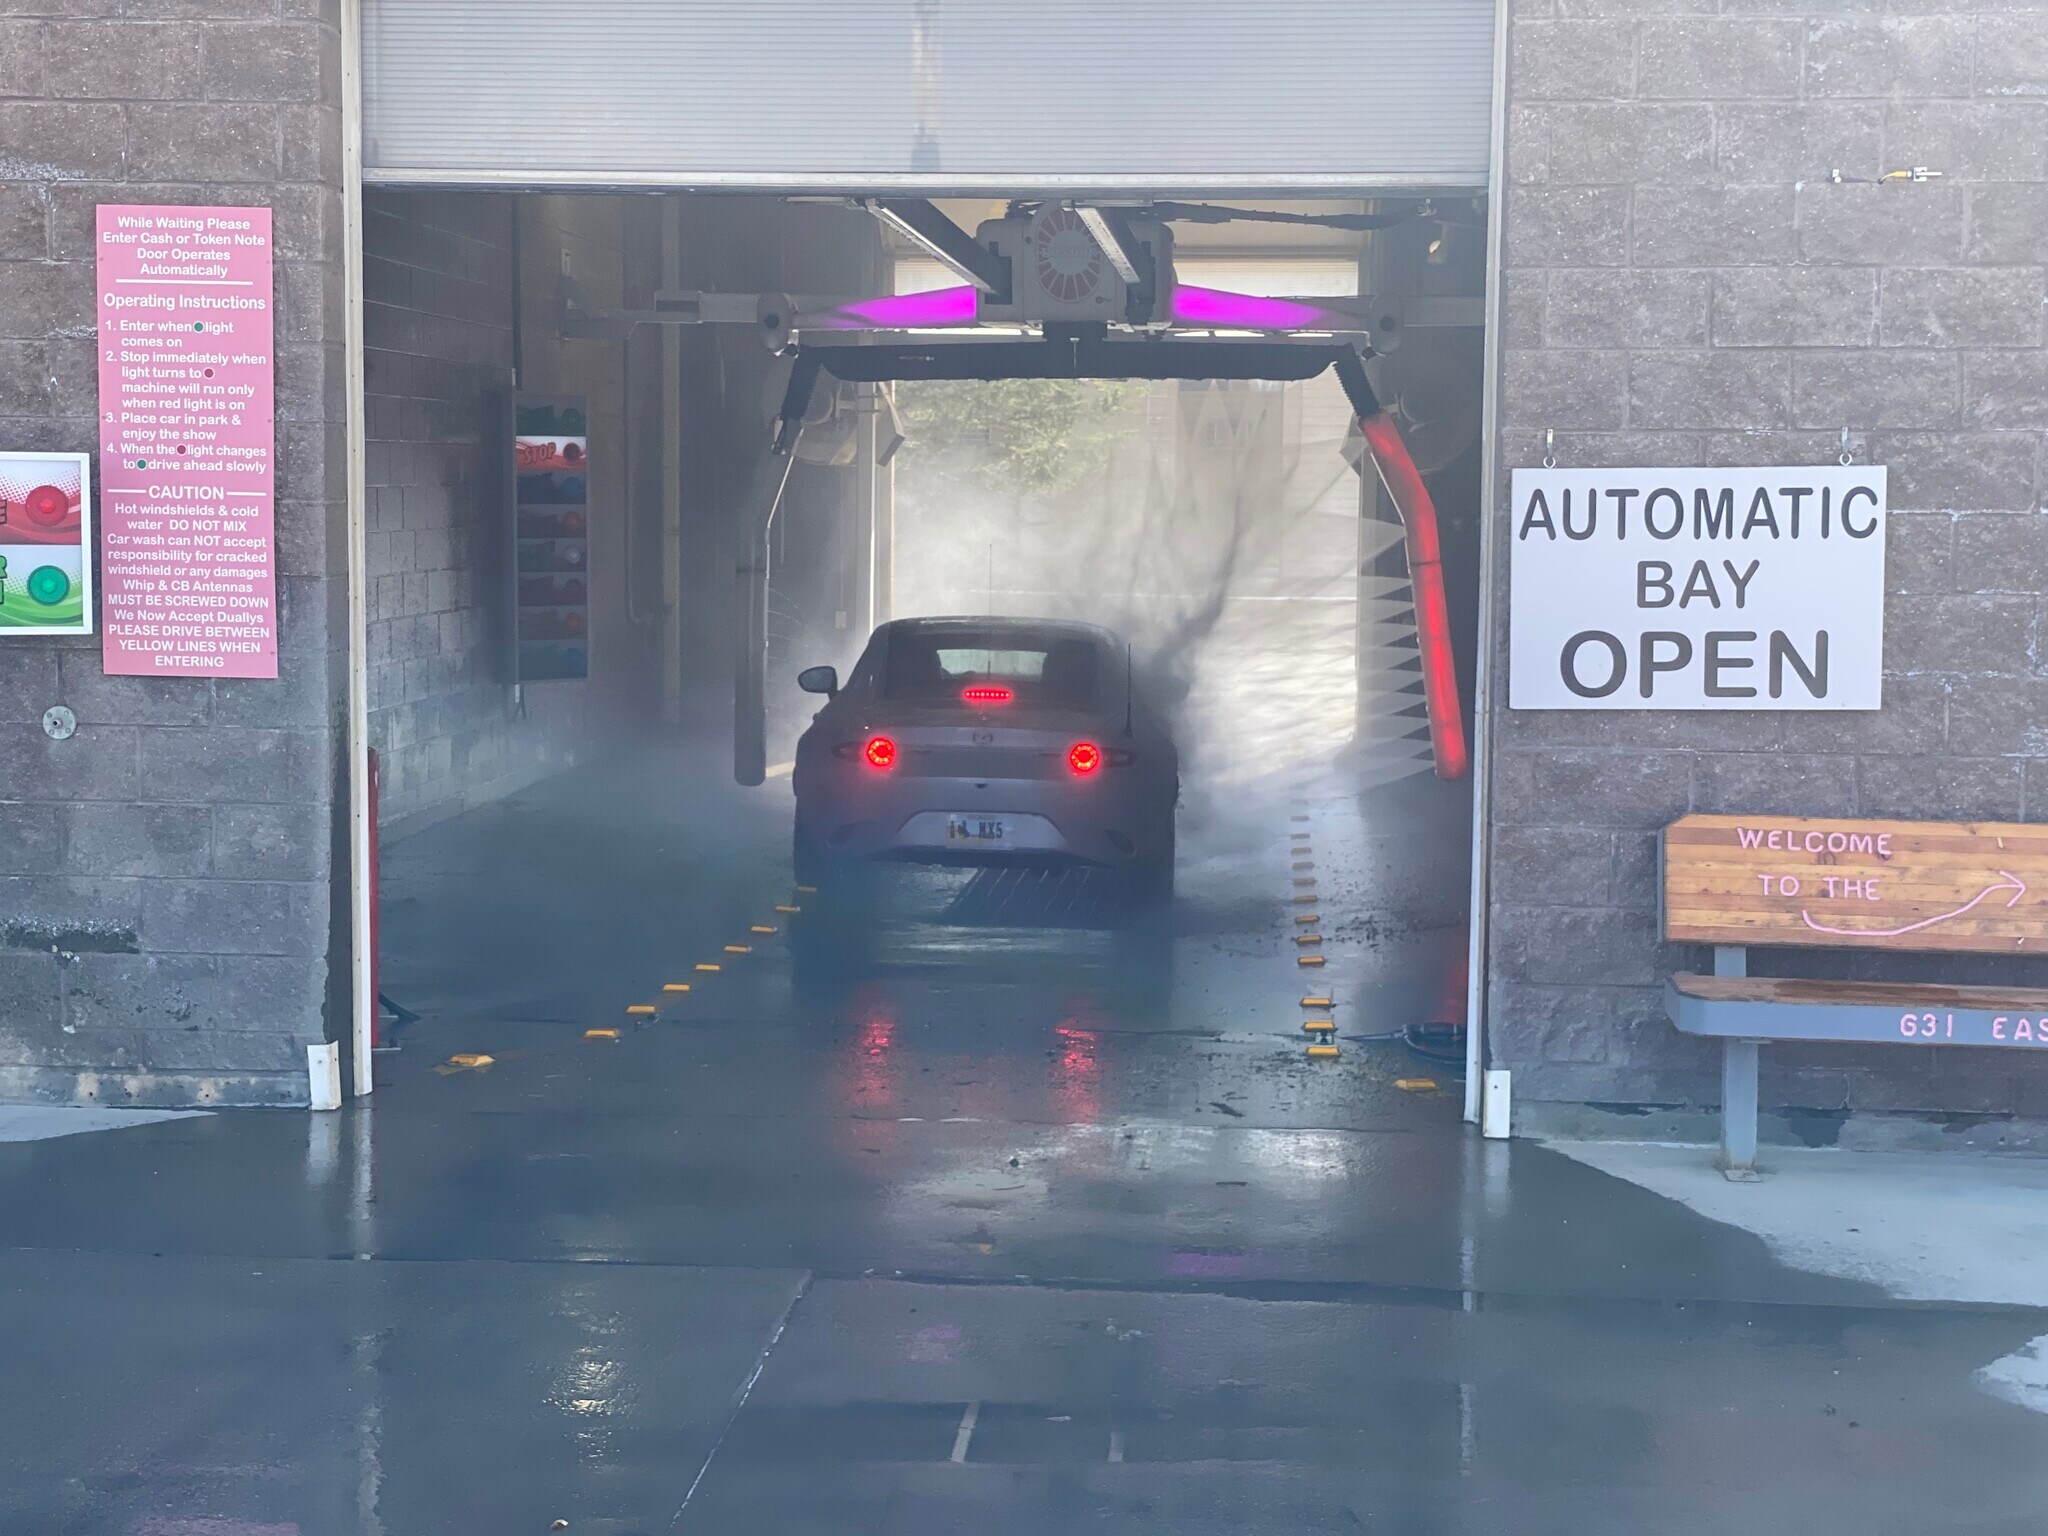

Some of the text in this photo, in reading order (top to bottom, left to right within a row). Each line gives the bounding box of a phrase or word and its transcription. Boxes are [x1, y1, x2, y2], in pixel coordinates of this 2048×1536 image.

[118, 216, 250, 232] While Waiting Please
[103, 232, 265, 246] Enter Cash or Token Note
[137, 248, 231, 262] Door Operates
[140, 263, 228, 278] Automatically
[104, 293, 266, 311] Operating Instructions
[105, 320, 234, 335] 1. Enter when light
[121, 338, 182, 347] comes on
[106, 350, 266, 366] 2. Stop immediately when
[122, 366, 202, 380] light turns to
[122, 382, 255, 398] machine will run only
[122, 397, 245, 412] when red light is on
[106, 412, 241, 427] 3. Place car in park &
[122, 428, 217, 441] enjoy the show
[106, 442, 267, 459] 4. When the light changes
[525, 441, 557, 465] STOP
[123, 458, 266, 474] to drive ahead slowly
[149, 485, 224, 500] CAUTION
[115, 503, 258, 517] Hot windshields & cold
[1518, 485, 1879, 541] AUTOMATIC
[127, 519, 247, 531] water DO NOT MIX
[107, 533, 267, 550] Car wash can NOT accept
[108, 549, 267, 564] responsibility for cracked
[108, 564, 268, 580] windshield or any damages
[123, 579, 253, 593] Whip & CB Antennas
[1636, 559, 1761, 610] BAY
[108, 594, 269, 608] MUST BE SCREWED DOWN
[114, 609, 264, 625] We Now Accept Duallys
[109, 624, 269, 638] PLEASE DRIVE BETWEEN
[119, 639, 260, 653] YELLOW LINES WHEN
[155, 655, 224, 667] ENTERING
[1559, 629, 1829, 699] OPEN
[1736, 826, 1892, 855] WELCOME
[1758, 874, 1881, 901] TO THE
[1900, 1013, 1953, 1037] 631
